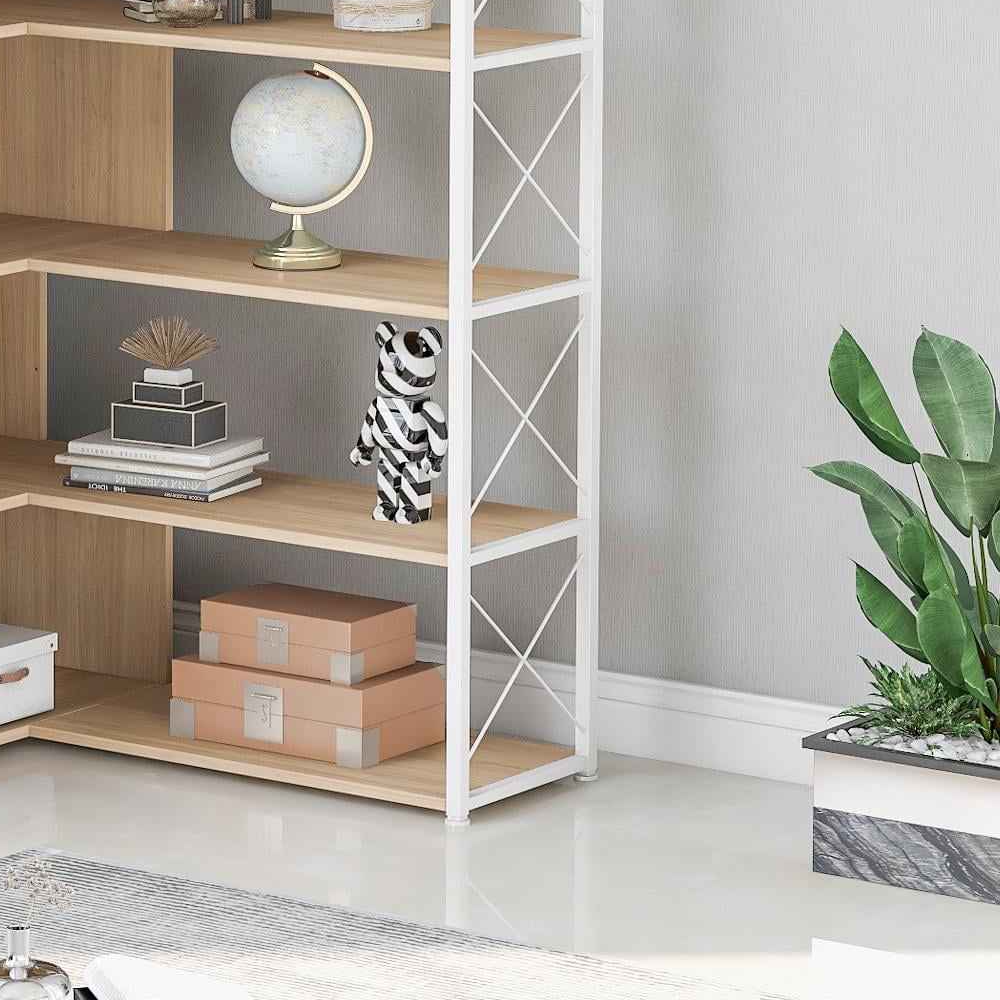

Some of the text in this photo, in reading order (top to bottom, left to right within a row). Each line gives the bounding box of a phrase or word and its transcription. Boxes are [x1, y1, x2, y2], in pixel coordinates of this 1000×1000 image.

[88, 482, 108, 492] IDIOT
[114, 474, 169, 489] KARENINA
[170, 479, 202, 491] ANNA
